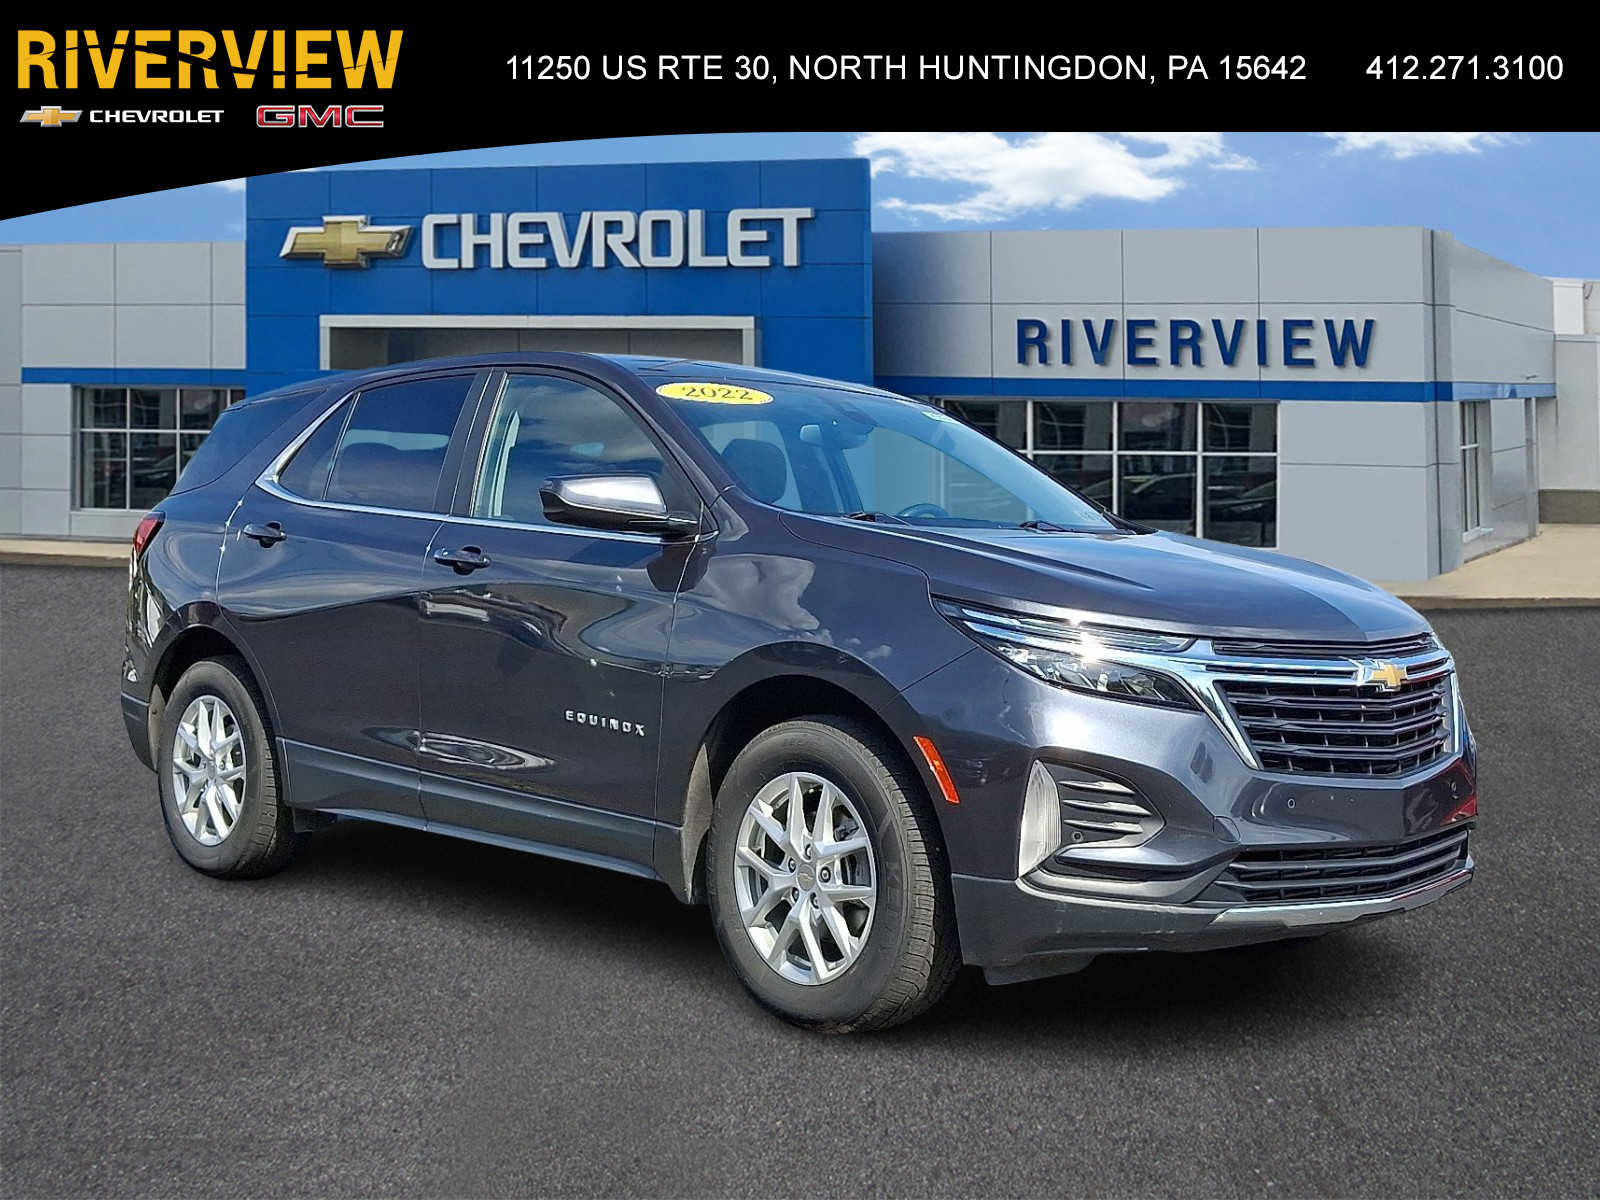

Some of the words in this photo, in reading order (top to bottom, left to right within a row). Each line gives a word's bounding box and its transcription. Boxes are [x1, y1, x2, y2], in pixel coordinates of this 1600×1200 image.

[421, 207, 815, 269] CHEVROLET
[1016, 319, 1375, 367] RIVERVIEW
[682, 387, 753, 400] 2022
[565, 710, 645, 737] EQUINOX
